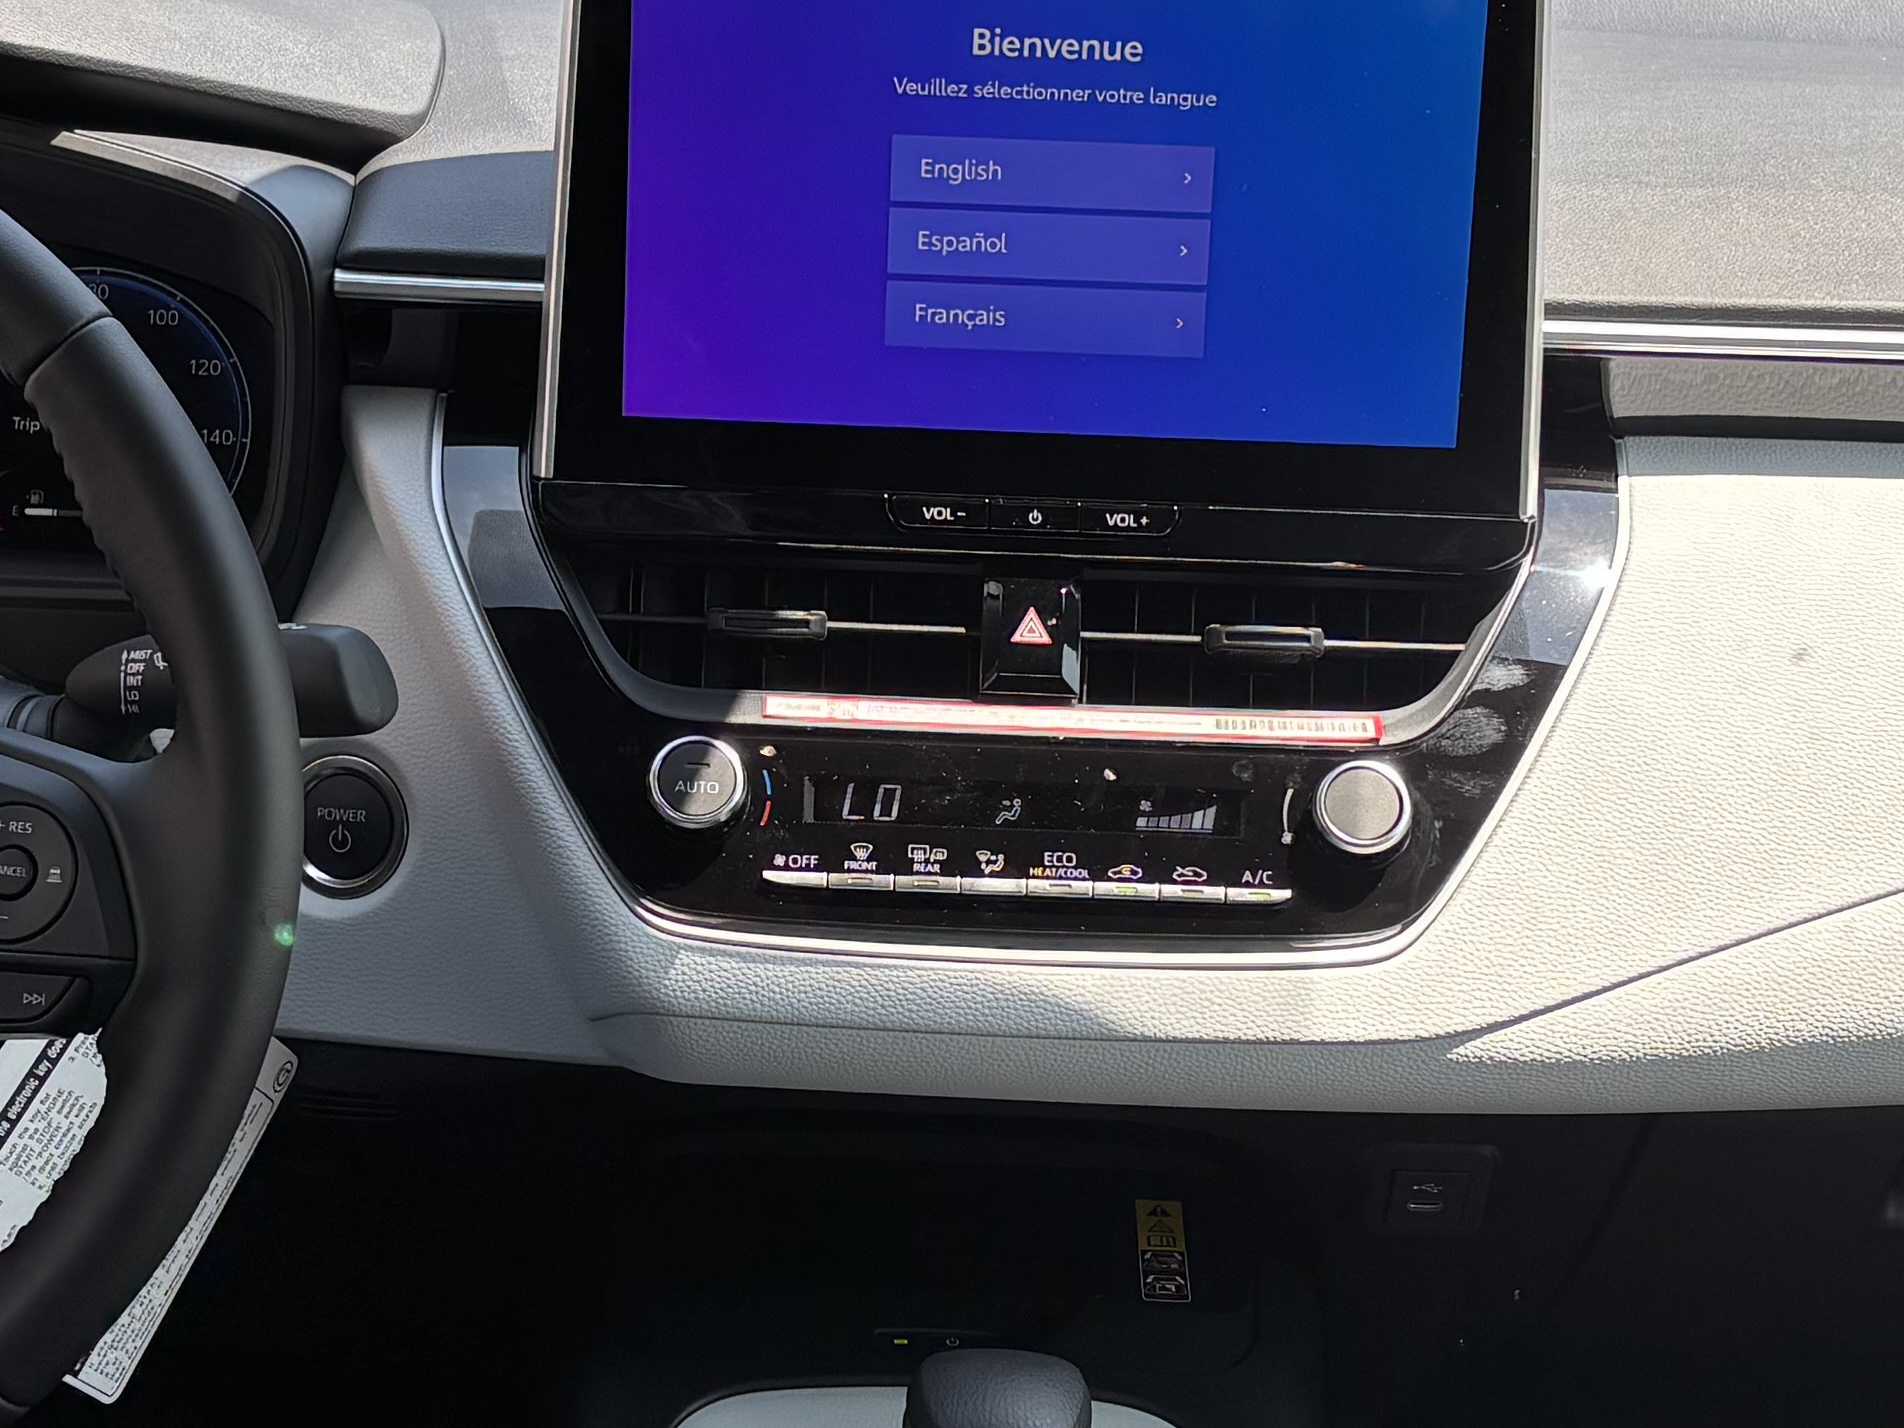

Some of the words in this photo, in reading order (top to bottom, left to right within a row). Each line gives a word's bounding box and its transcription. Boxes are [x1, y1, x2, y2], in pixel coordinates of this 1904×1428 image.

[971, 28, 1144, 63] Bienvenue
[893, 77, 968, 98] Veuillez
[973, 81, 1091, 103] sélectionner
[1095, 89, 1144, 105] votre
[1149, 87, 1218, 111] langue
[920, 159, 1002, 185] English
[917, 230, 1007, 256] Español
[146, 309, 180, 327] 100
[914, 303, 1006, 330] Français
[189, 359, 223, 377] 120
[13, 417, 42, 435] Trip
[200, 428, 234, 447] 140
[128, 649, 154, 661] MIST
[127, 662, 146, 674] OFF
[126, 675, 143, 687] INT
[126, 689, 140, 701] LO
[674, 779, 720, 794] AUTO
[841, 782, 903, 822] LO
[317, 807, 367, 822] POWER
[8, 821, 33, 834] RES
[788, 853, 819, 869] OFF
[843, 860, 878, 872] FRONT
[912, 861, 941, 874] REAR
[1043, 851, 1077, 868] ECO
[1029, 867, 1091, 880] HEAT/COOL
[1240, 869, 1274, 886] A/C
[5, 1078, 40, 1120] electronic
